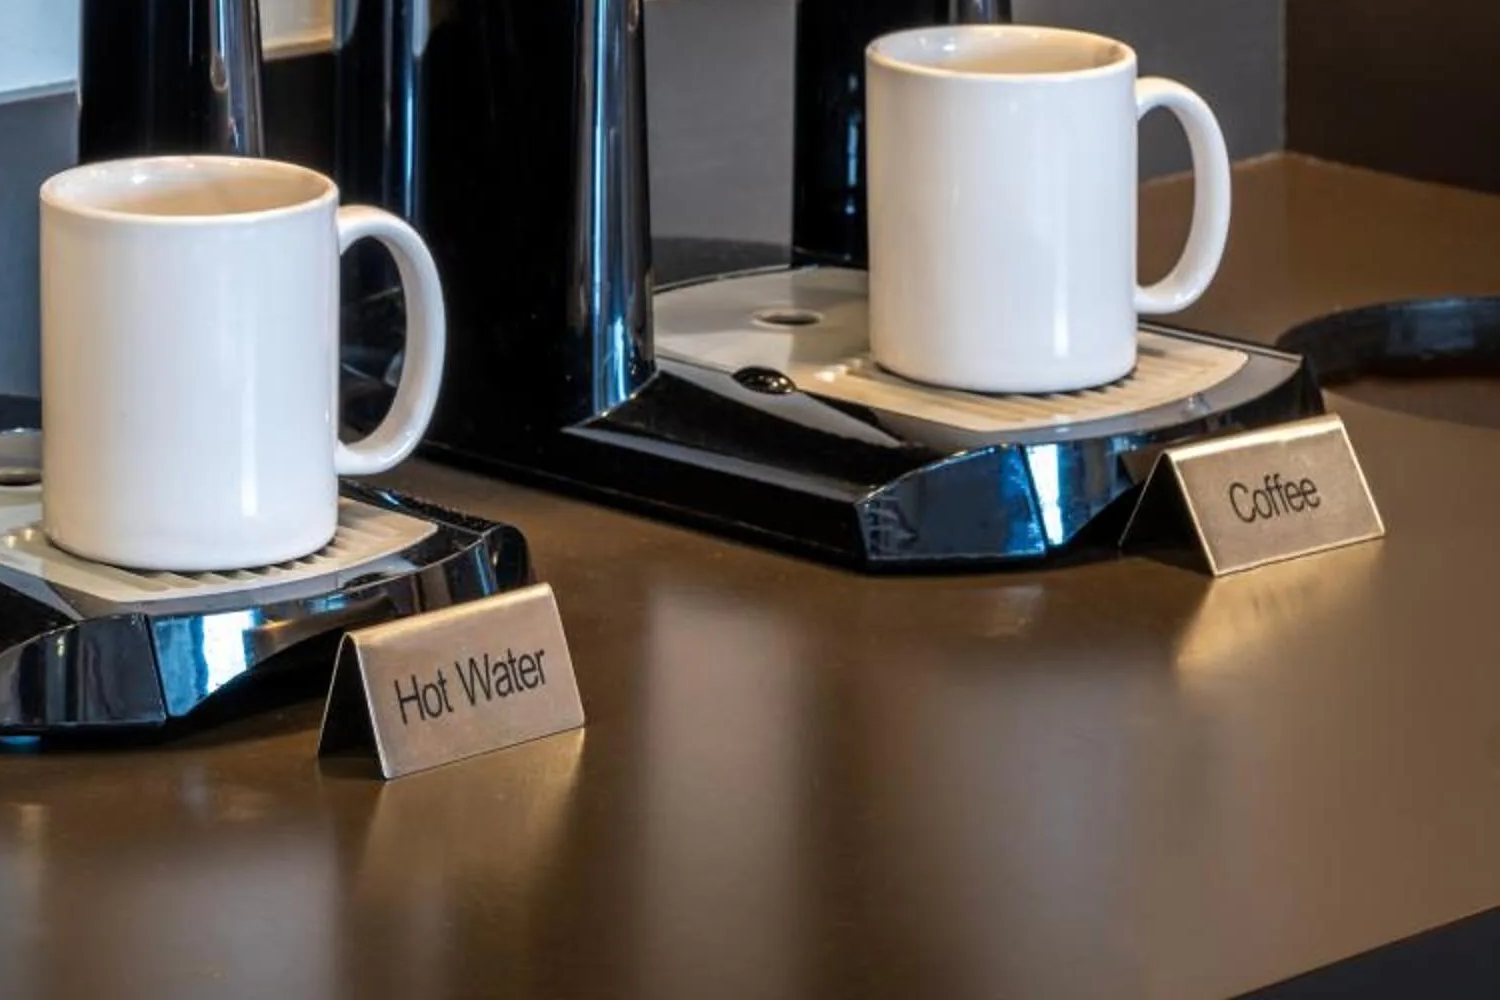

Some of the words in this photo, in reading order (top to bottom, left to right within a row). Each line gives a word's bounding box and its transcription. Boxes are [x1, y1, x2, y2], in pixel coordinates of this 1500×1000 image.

[1229, 473, 1321, 523] Coffee
[394, 669, 453, 725] Hot
[455, 648, 546, 706] Water
